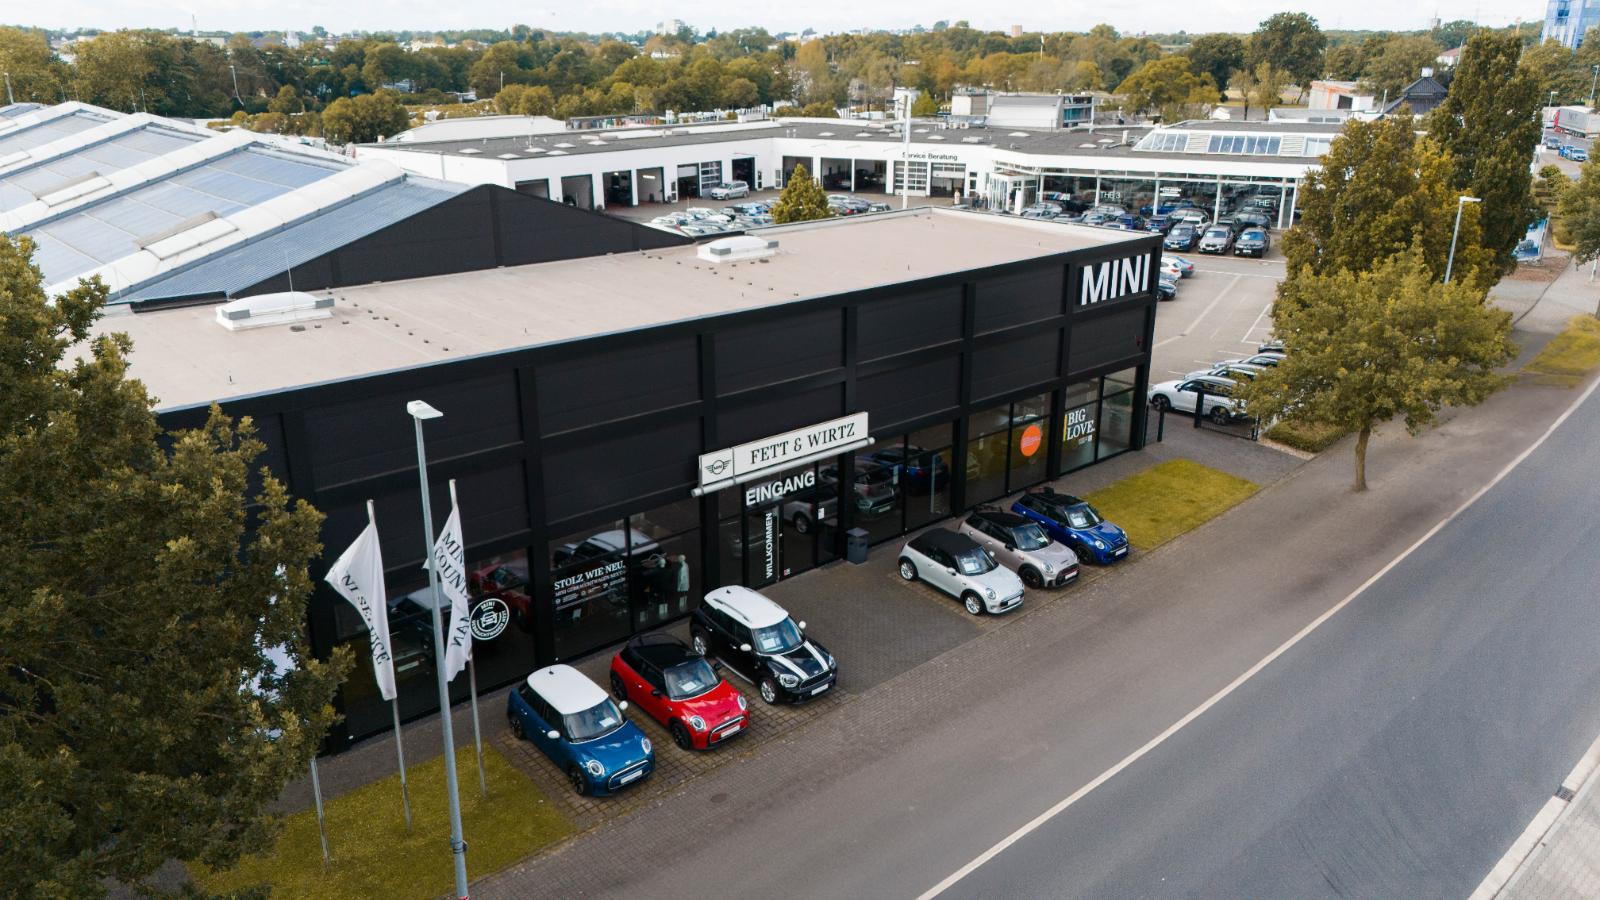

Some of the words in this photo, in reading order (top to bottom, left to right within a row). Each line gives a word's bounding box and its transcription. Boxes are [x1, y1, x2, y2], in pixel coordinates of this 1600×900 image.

[928, 153, 958, 161] Beratung
[1081, 253, 1151, 306] MINI
[1068, 408, 1086, 426] BIG
[751, 441, 789, 464] FETT
[793, 437, 802, 452] &
[807, 422, 855, 448] WIRTZ
[746, 471, 815, 506] EINGANG
[442, 531, 466, 568] MIN
[765, 512, 773, 579] WILLKOMMEN
[554, 573, 584, 590] STOLZ
[584, 567, 604, 580] WIE
[480, 601, 495, 610] MINI
